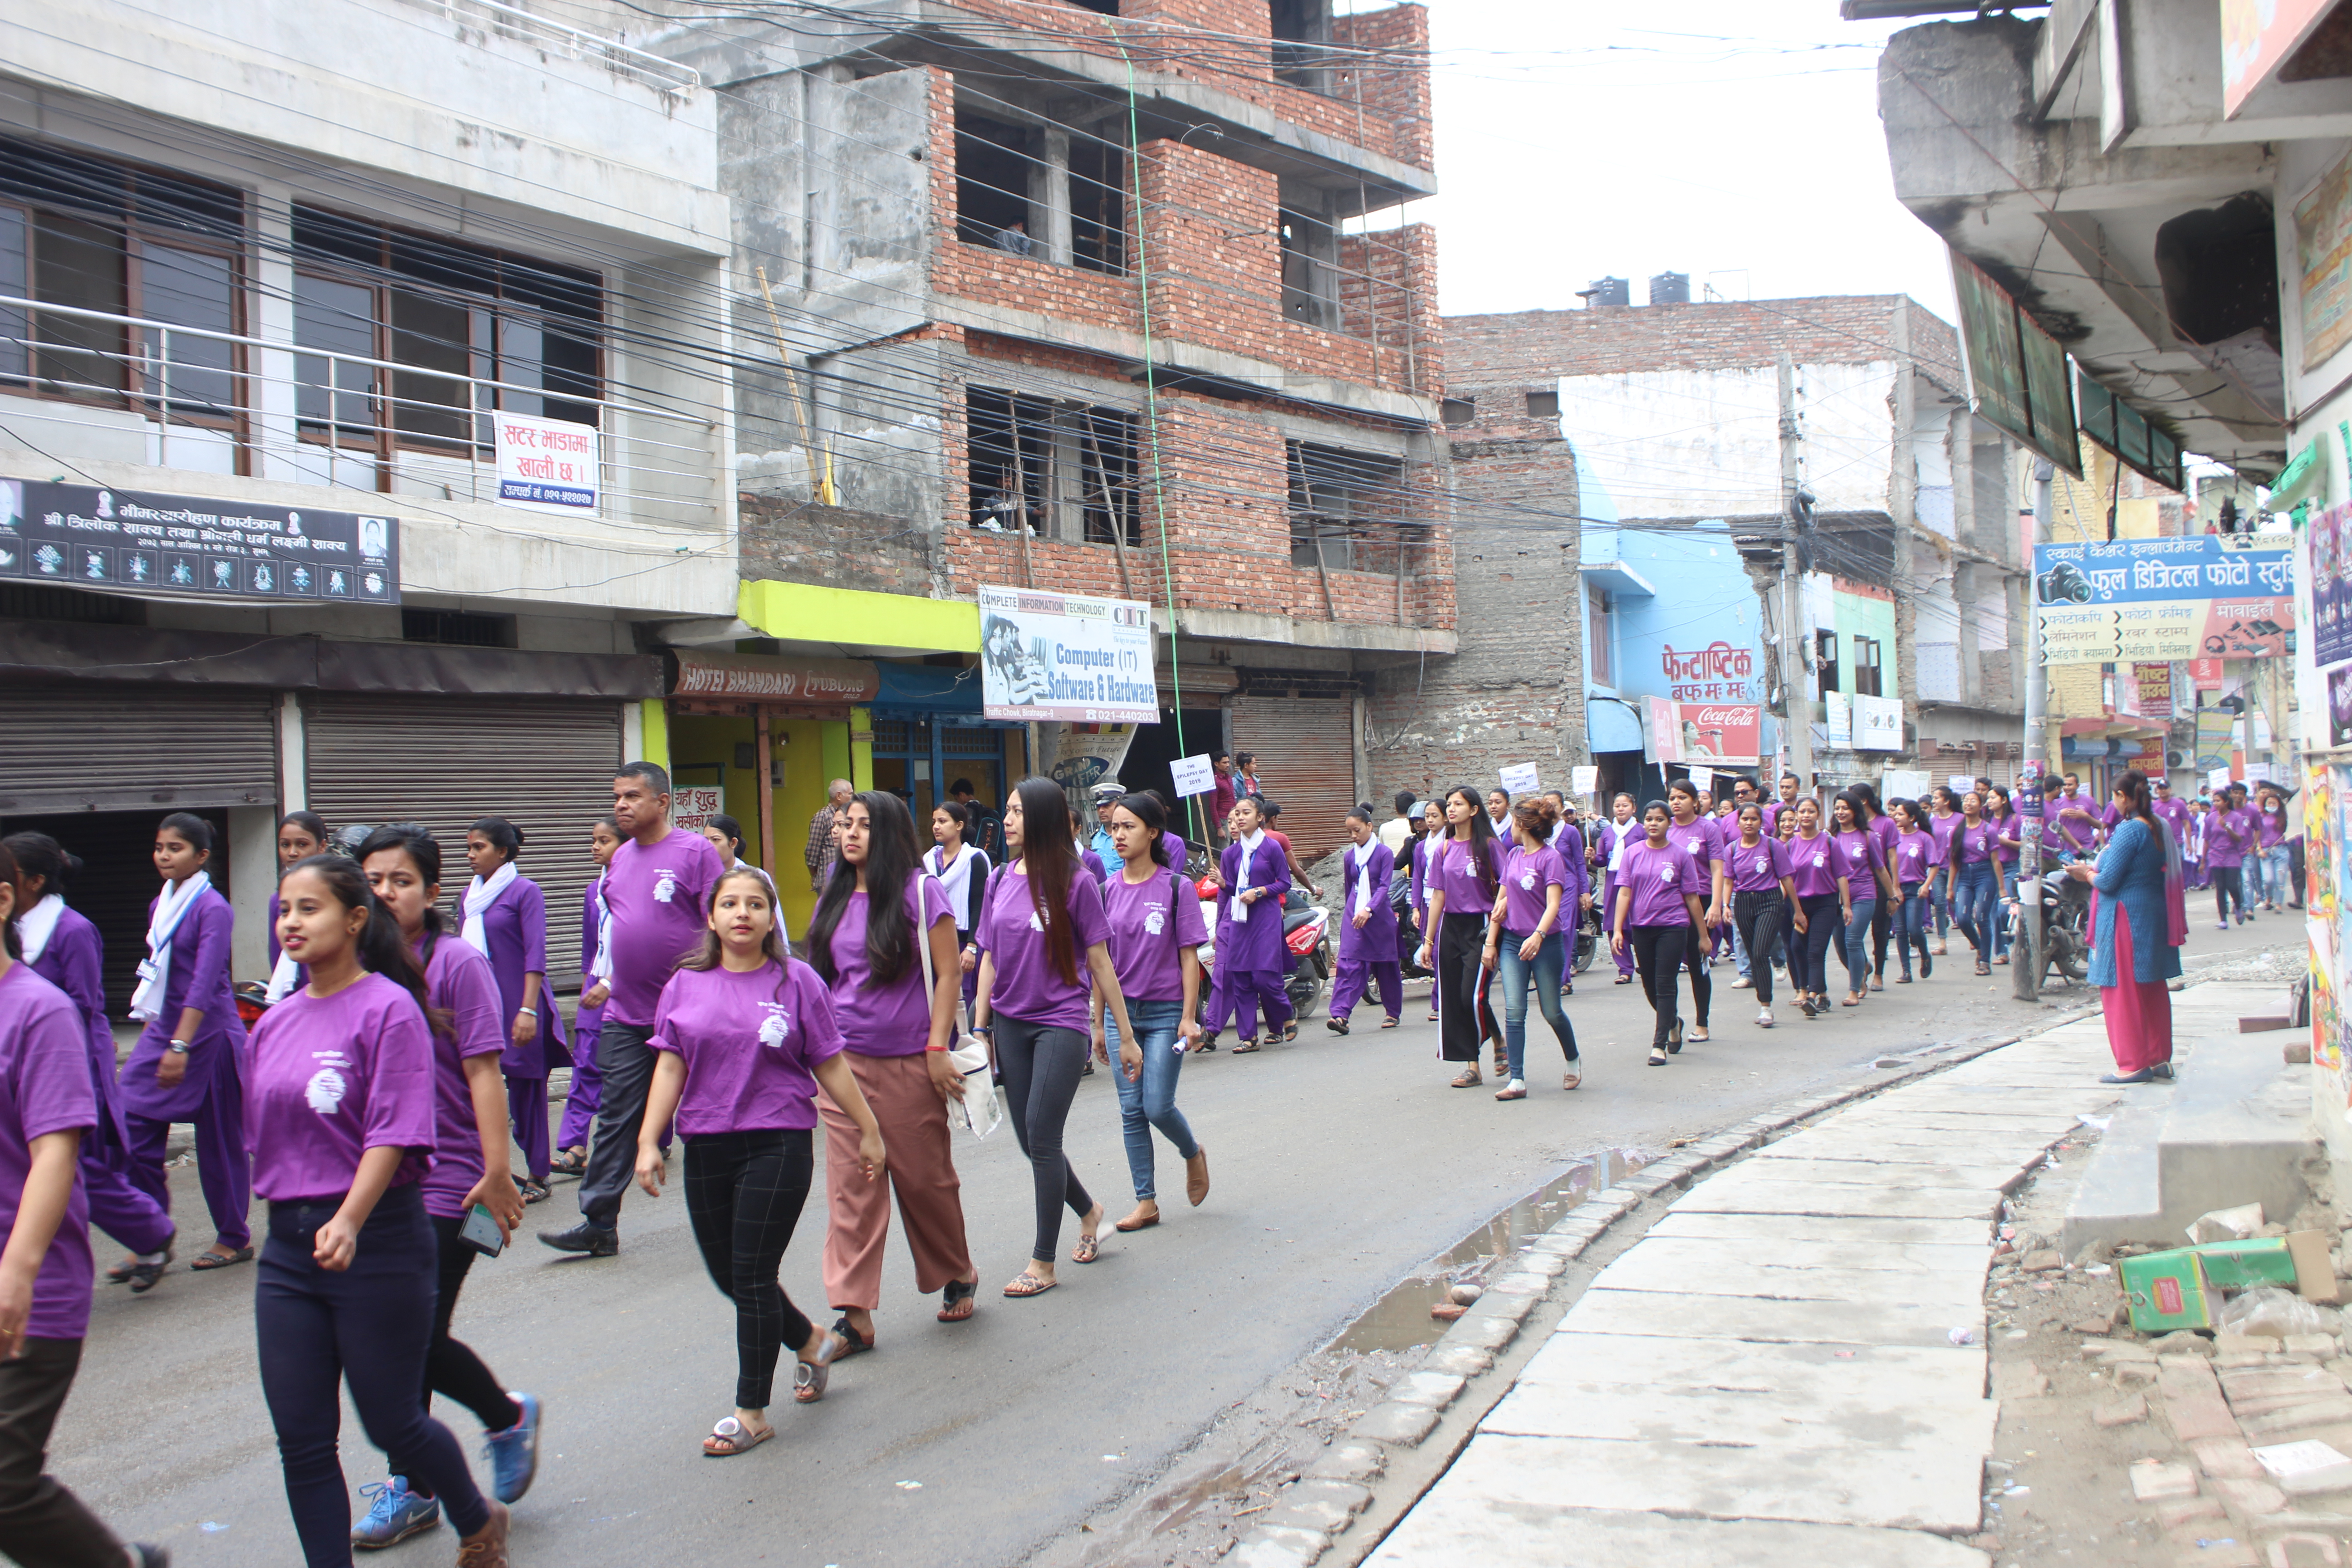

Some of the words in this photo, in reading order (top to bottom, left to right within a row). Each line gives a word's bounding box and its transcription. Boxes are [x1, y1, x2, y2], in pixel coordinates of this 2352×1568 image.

[504, 424, 536, 447] सटर
[541, 430, 588, 454] भाडामा
[516, 454, 554, 479] खाली
[559, 462, 573, 481] छ
[505, 484, 531, 497] सम्पर्क
[44, 511, 63, 526] श्री
[67, 514, 119, 530] त्रिलोक
[122, 522, 164, 536] शाक्य
[167, 527, 196, 539] तथा
[246, 532, 270, 545] धर्म
[272, 535, 308, 549] लक्ष्मी
[312, 539, 346, 551] शाक्य
[221, 515, 282, 531] कार्यक्रम
[2089, 568, 2127, 600] फुल
[2133, 559, 2200, 588] डिजिटल
[2205, 554, 2250, 585] फोटो
[981, 593, 1017, 608] COMPLETE
[1019, 597, 1064, 612] INFORMATION
[1066, 602, 1106, 616] TECHNOLOGY
[1113, 607, 1147, 626] CIT
[2124, 607, 2152, 620] फोटो
[1056, 642, 1114, 671] Computer
[1118, 648, 1137, 672] (IT)
[683, 666, 725, 691] HOTEL
[725, 671, 796, 695] BHANDARI
[1048, 671, 1094, 701] Software
[1097, 674, 1104, 701] &
[1107, 675, 1155, 704] Hardware
[1671, 683, 1702, 701] बफ
[985, 707, 1002, 716] Traffic
[1003, 708, 1021, 718] Chowk,
[1098, 710, 1154, 721] 021-440203
[1698, 706, 1758, 726] Coca-Cola
[1095, 745, 1122, 754] Future
[1176, 771, 1198, 779] EPILEPSY
